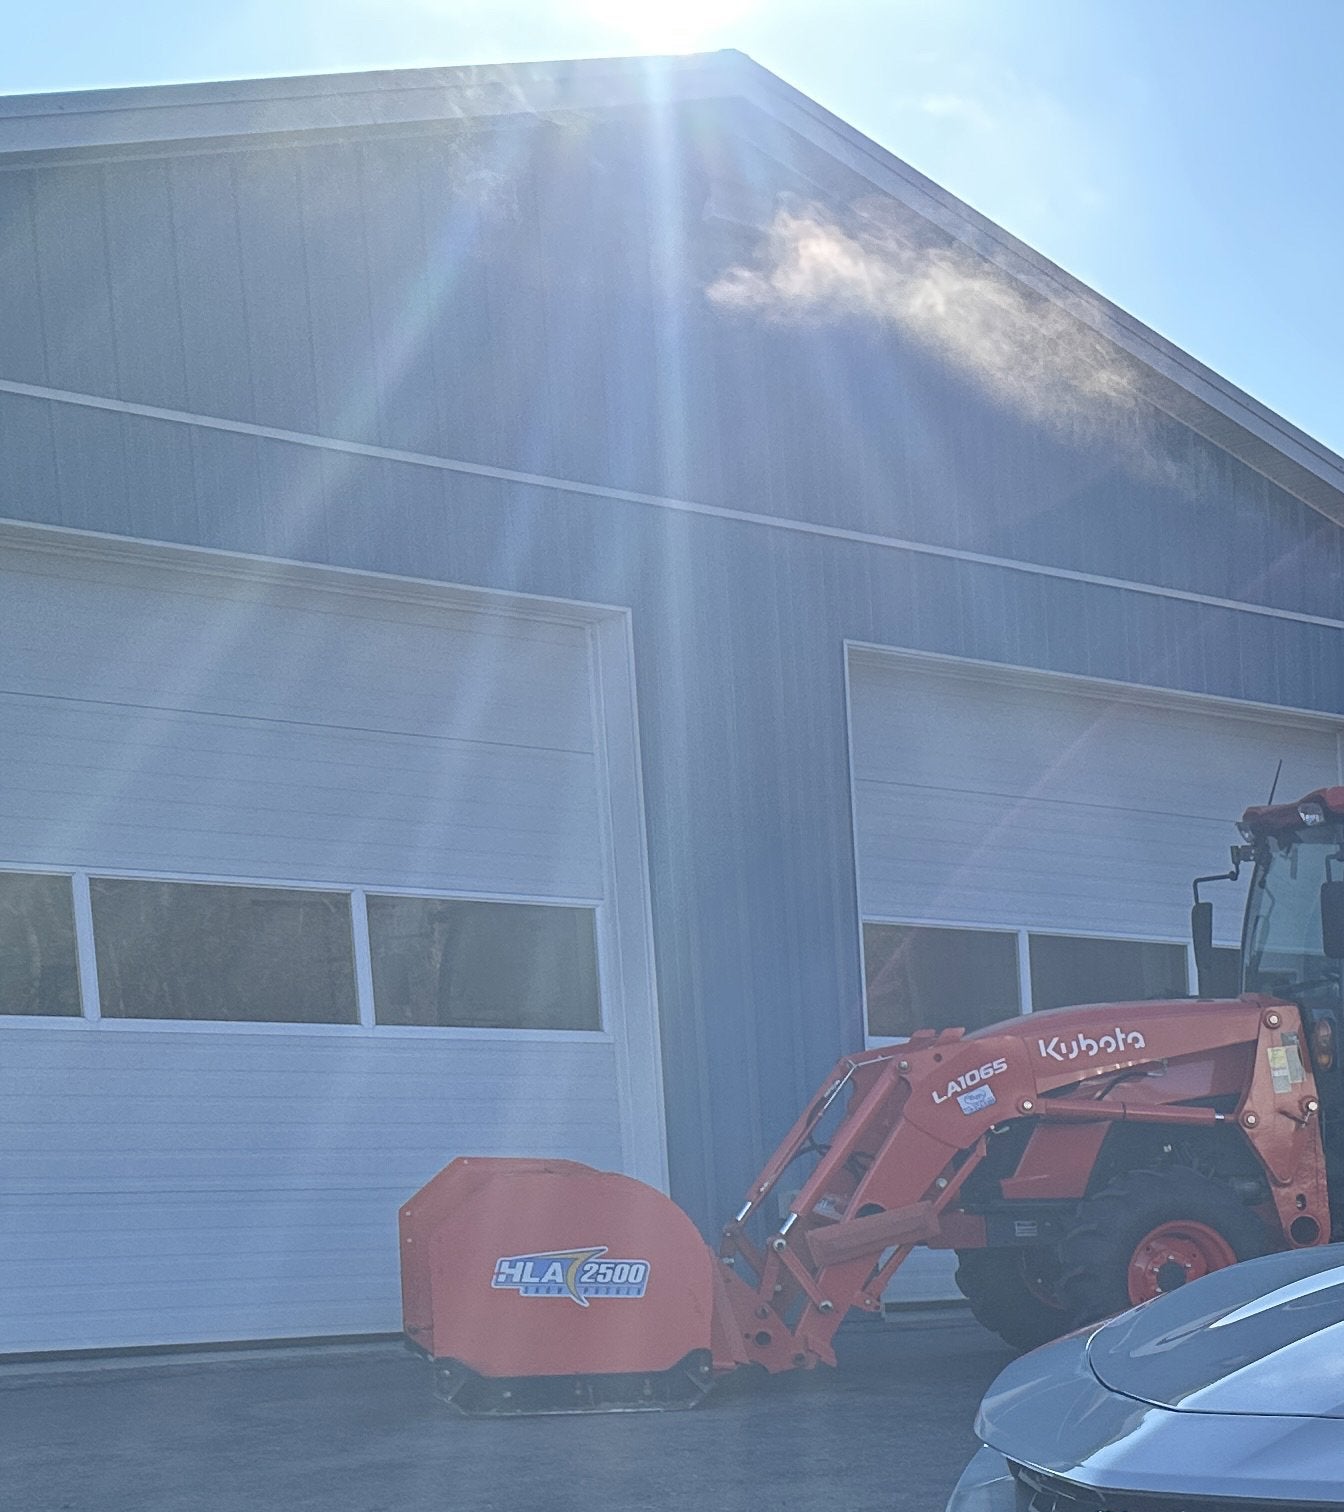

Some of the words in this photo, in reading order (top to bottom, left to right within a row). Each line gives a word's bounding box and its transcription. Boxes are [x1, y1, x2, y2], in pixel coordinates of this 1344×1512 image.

[1038, 1028, 1145, 1061] Kubota
[931, 1058, 1008, 1104] LA1065
[497, 1261, 564, 1283] HLA
[580, 1263, 646, 1283] 2500
